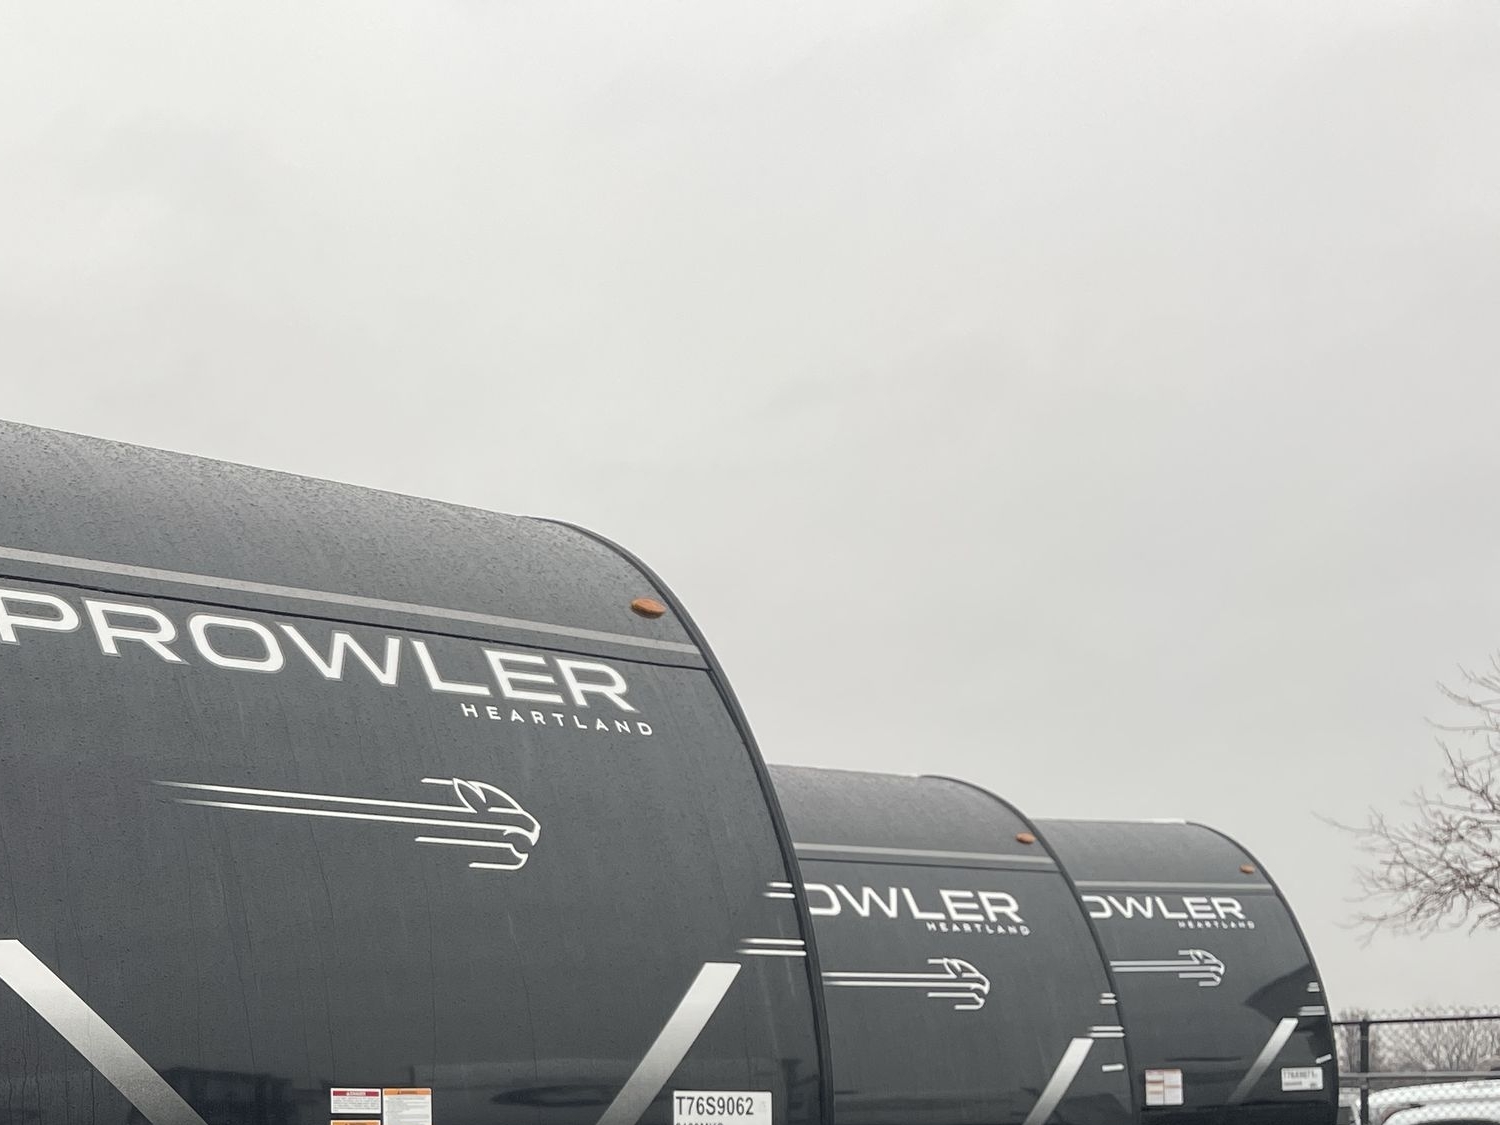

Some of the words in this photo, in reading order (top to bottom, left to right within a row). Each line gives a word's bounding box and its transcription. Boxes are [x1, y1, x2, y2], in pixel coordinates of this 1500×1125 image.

[460, 702, 653, 736] HEARTLAND
[925, 921, 1031, 937] HEARTLAND
[675, 1096, 755, 1116] T76S9062
